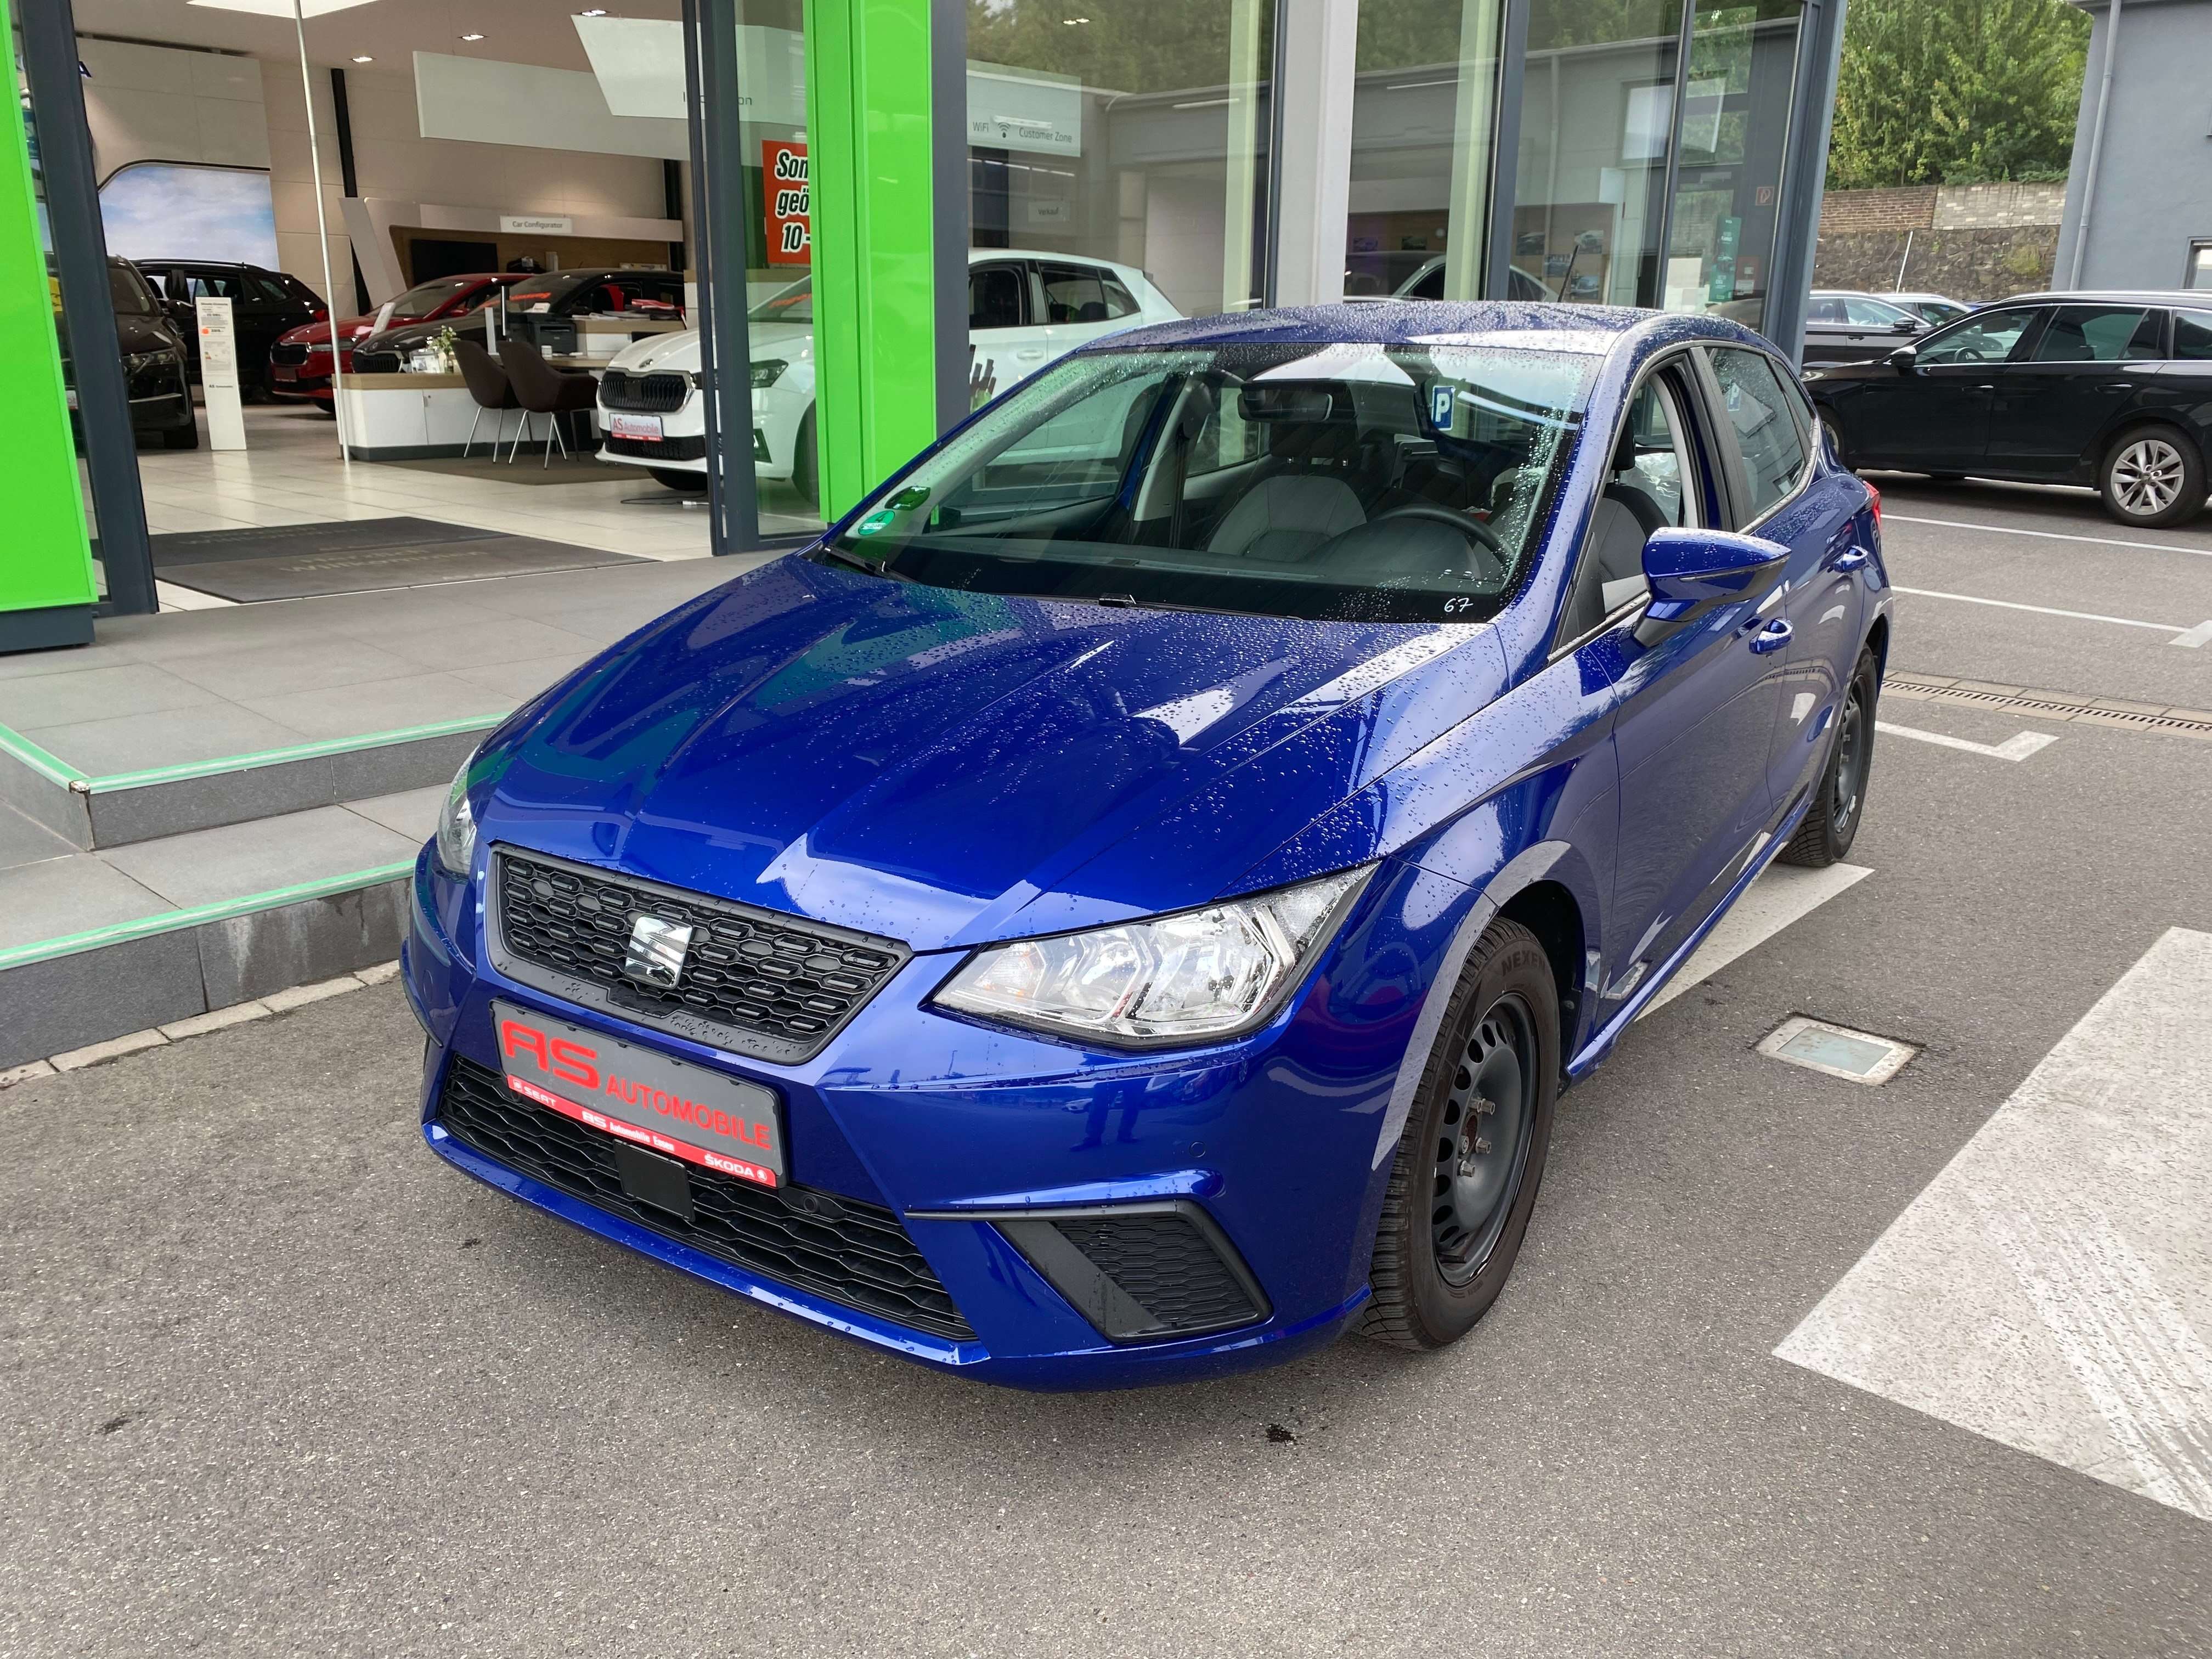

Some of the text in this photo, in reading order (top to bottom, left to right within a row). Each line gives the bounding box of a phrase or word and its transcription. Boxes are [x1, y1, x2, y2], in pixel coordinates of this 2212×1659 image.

[973, 122, 989, 132] WiFi
[1019, 127, 1072, 143] Customer Zone
[1435, 393, 1450, 422] P
[613, 417, 623, 431] AS
[875, 511, 889, 523] 4
[279, 551, 489, 572] Willkommen
[1444, 597, 1474, 612] 67
[1501, 950, 1546, 977] NEXEN
[501, 1019, 772, 1150] AS AUTOMOBILE
[523, 1086, 557, 1107] SEAT
[582, 1110, 675, 1152] AS Automobile Essen
[704, 1153, 754, 1178] ŠKODA
